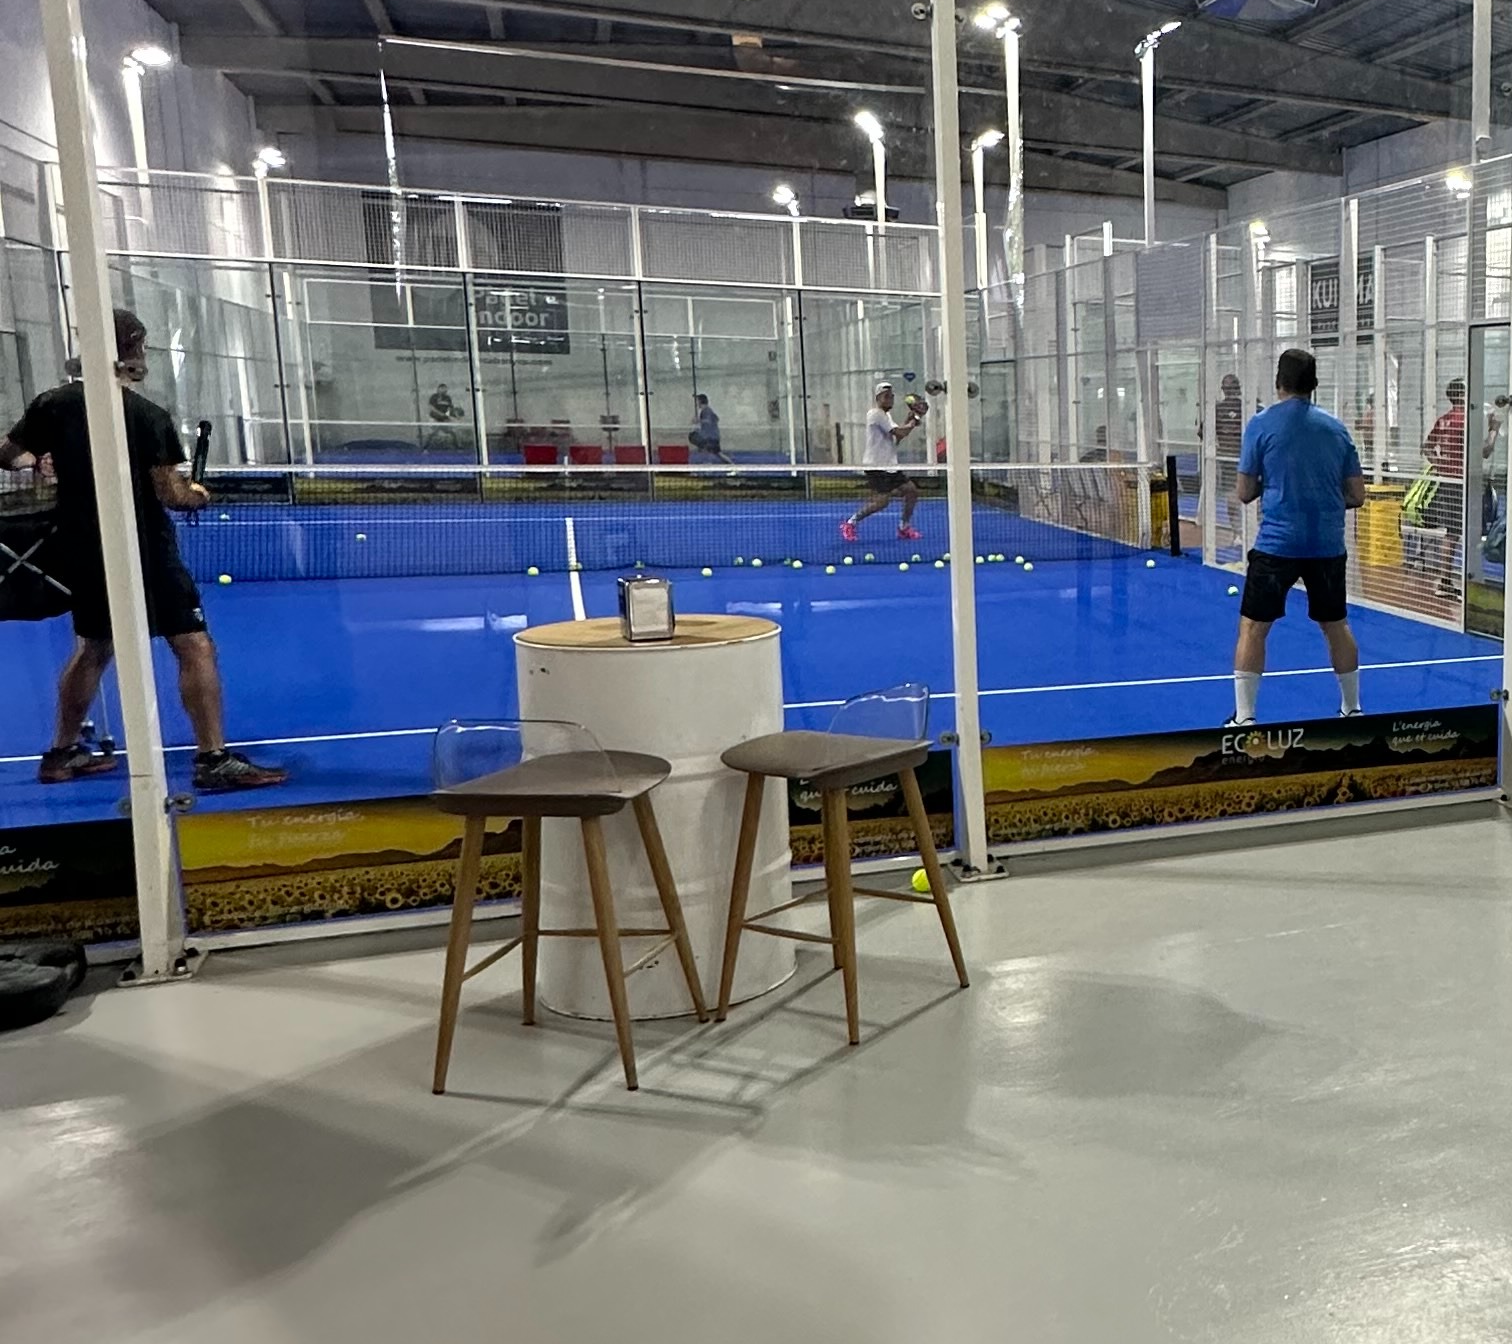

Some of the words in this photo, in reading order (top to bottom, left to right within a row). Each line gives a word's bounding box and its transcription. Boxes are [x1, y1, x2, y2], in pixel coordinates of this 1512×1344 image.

[1221, 728, 1305, 754] ECOLUZ
[1391, 735, 1413, 747] que
[1427, 729, 1461, 741] cuida
[800, 789, 822, 802] qu
[851, 780, 898, 796] cuida
[0, 858, 61, 875] uida
